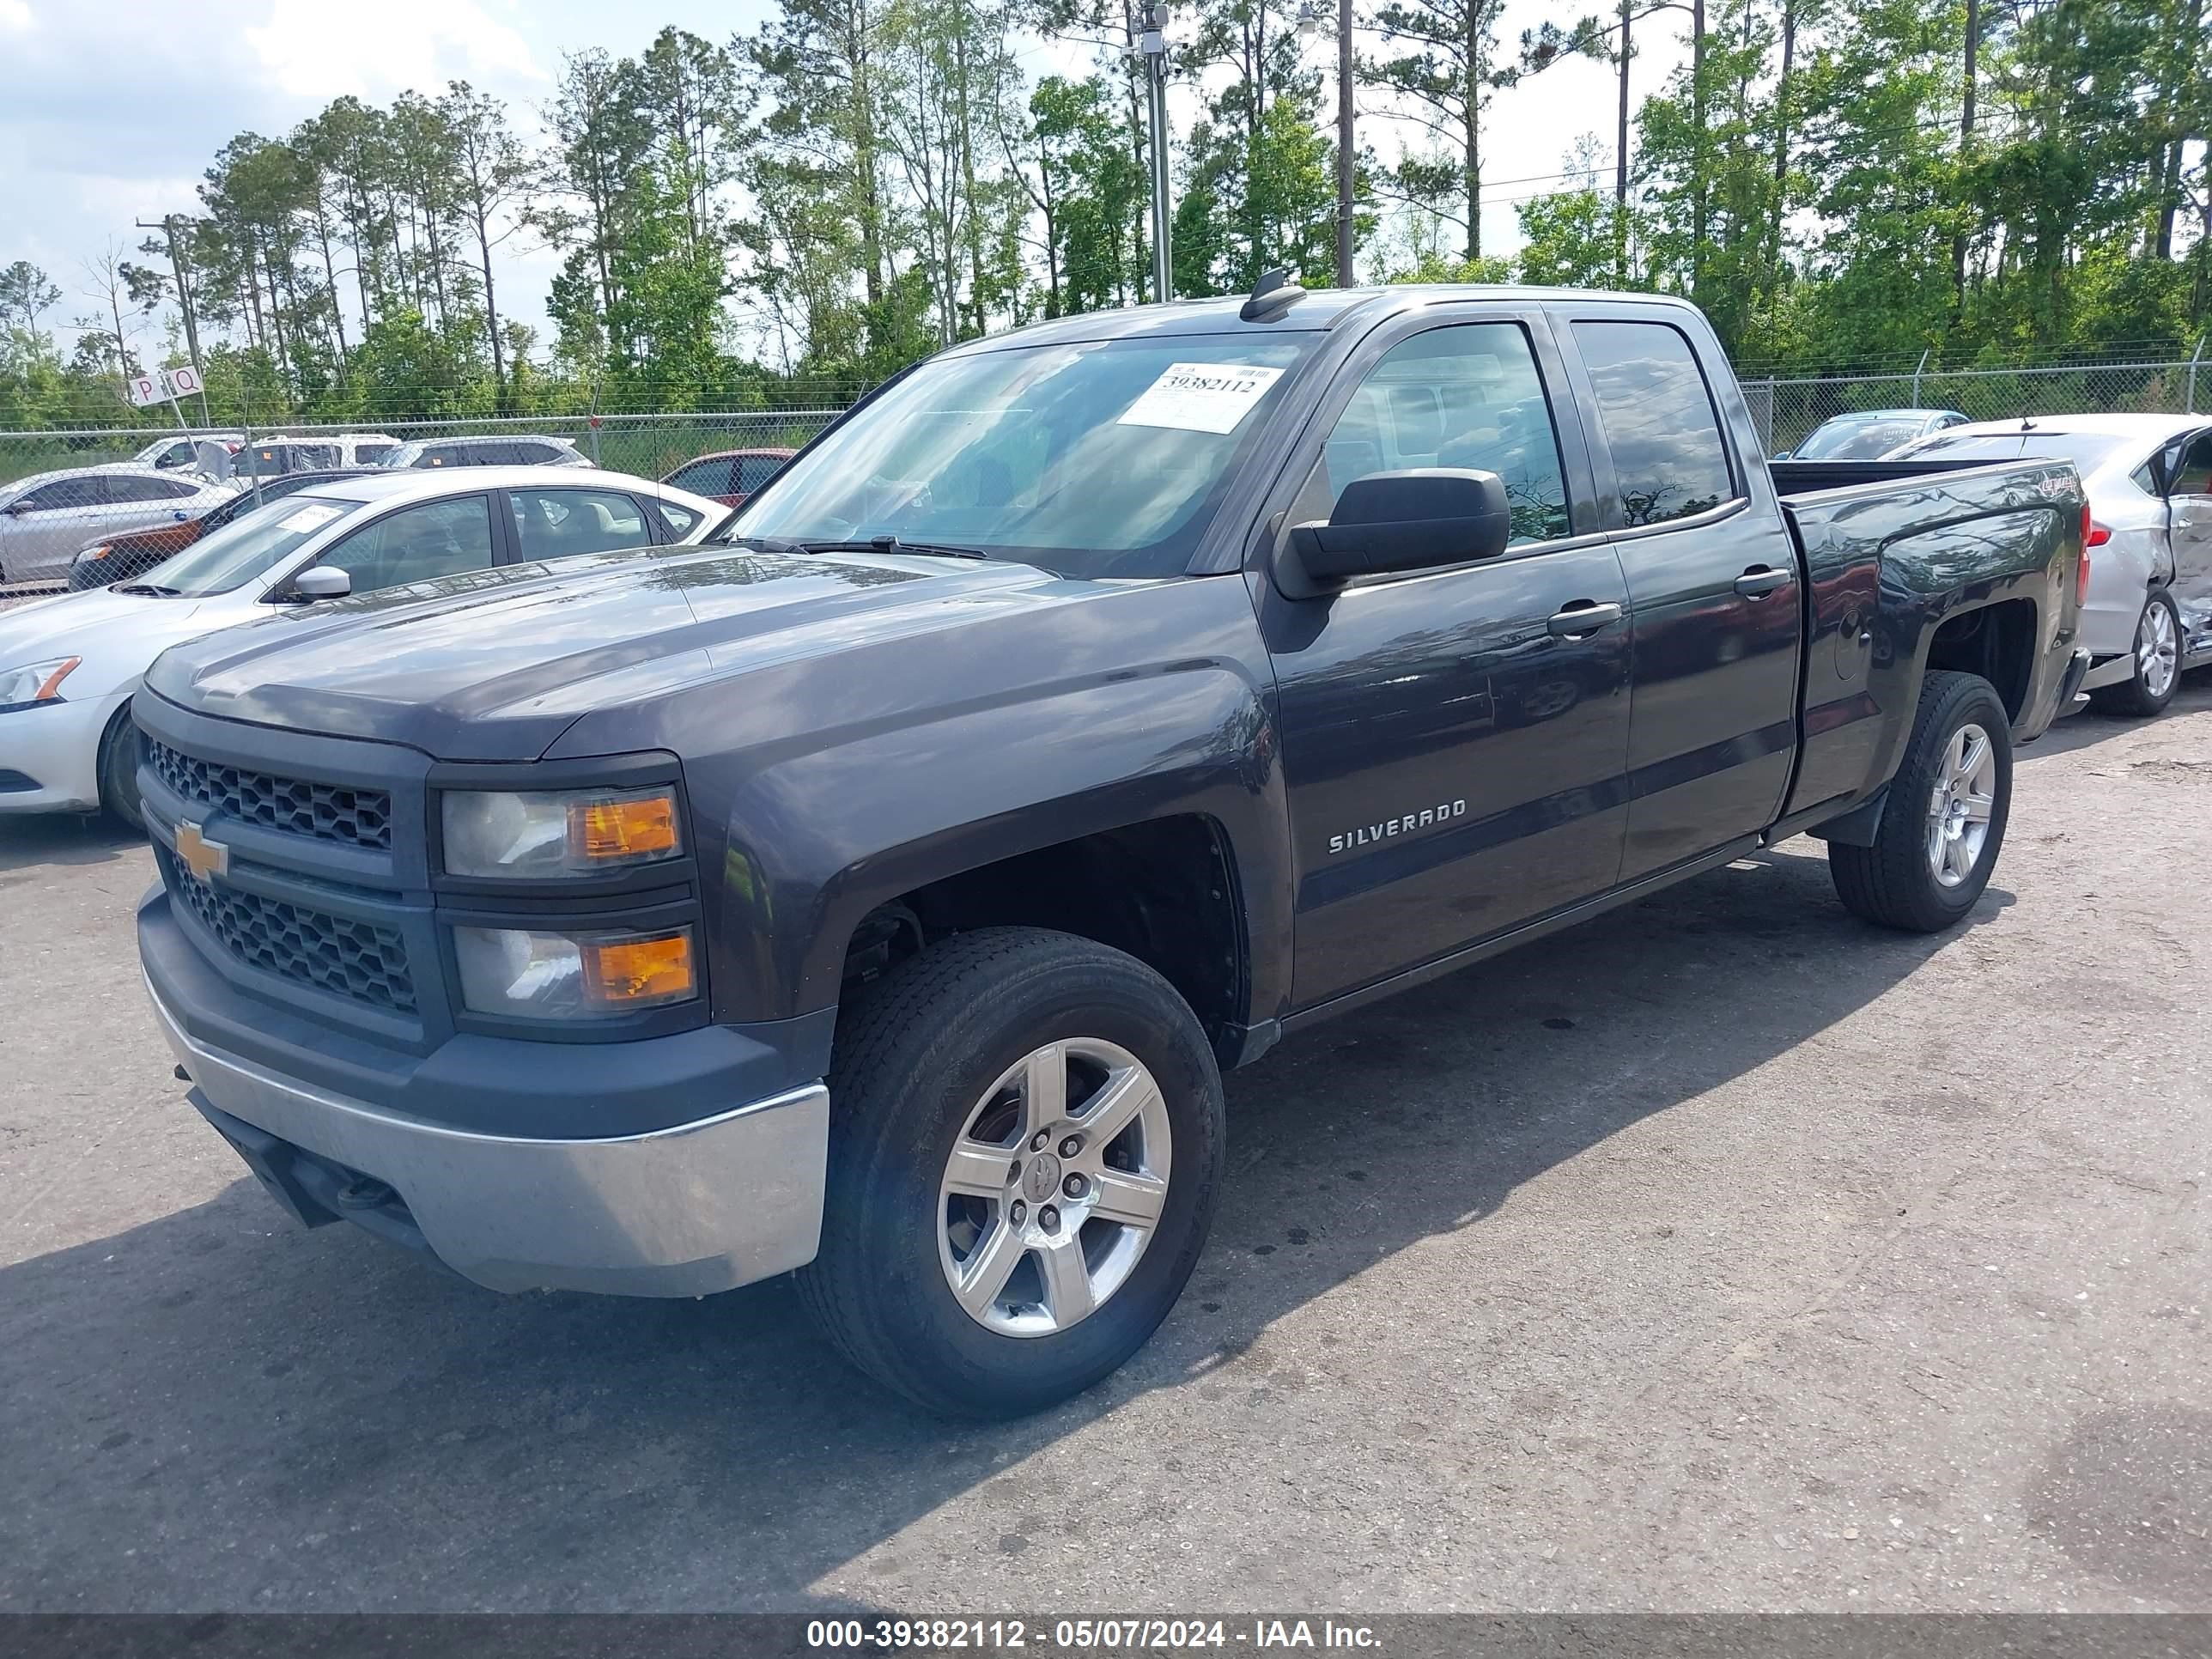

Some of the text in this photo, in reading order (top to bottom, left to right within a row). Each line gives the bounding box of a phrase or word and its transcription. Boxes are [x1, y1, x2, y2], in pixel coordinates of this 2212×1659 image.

[139, 380, 152, 401] P
[175, 370, 199, 391] Q
[1163, 376, 1256, 394] 39382112
[1328, 799, 1467, 854] SILVERADO
